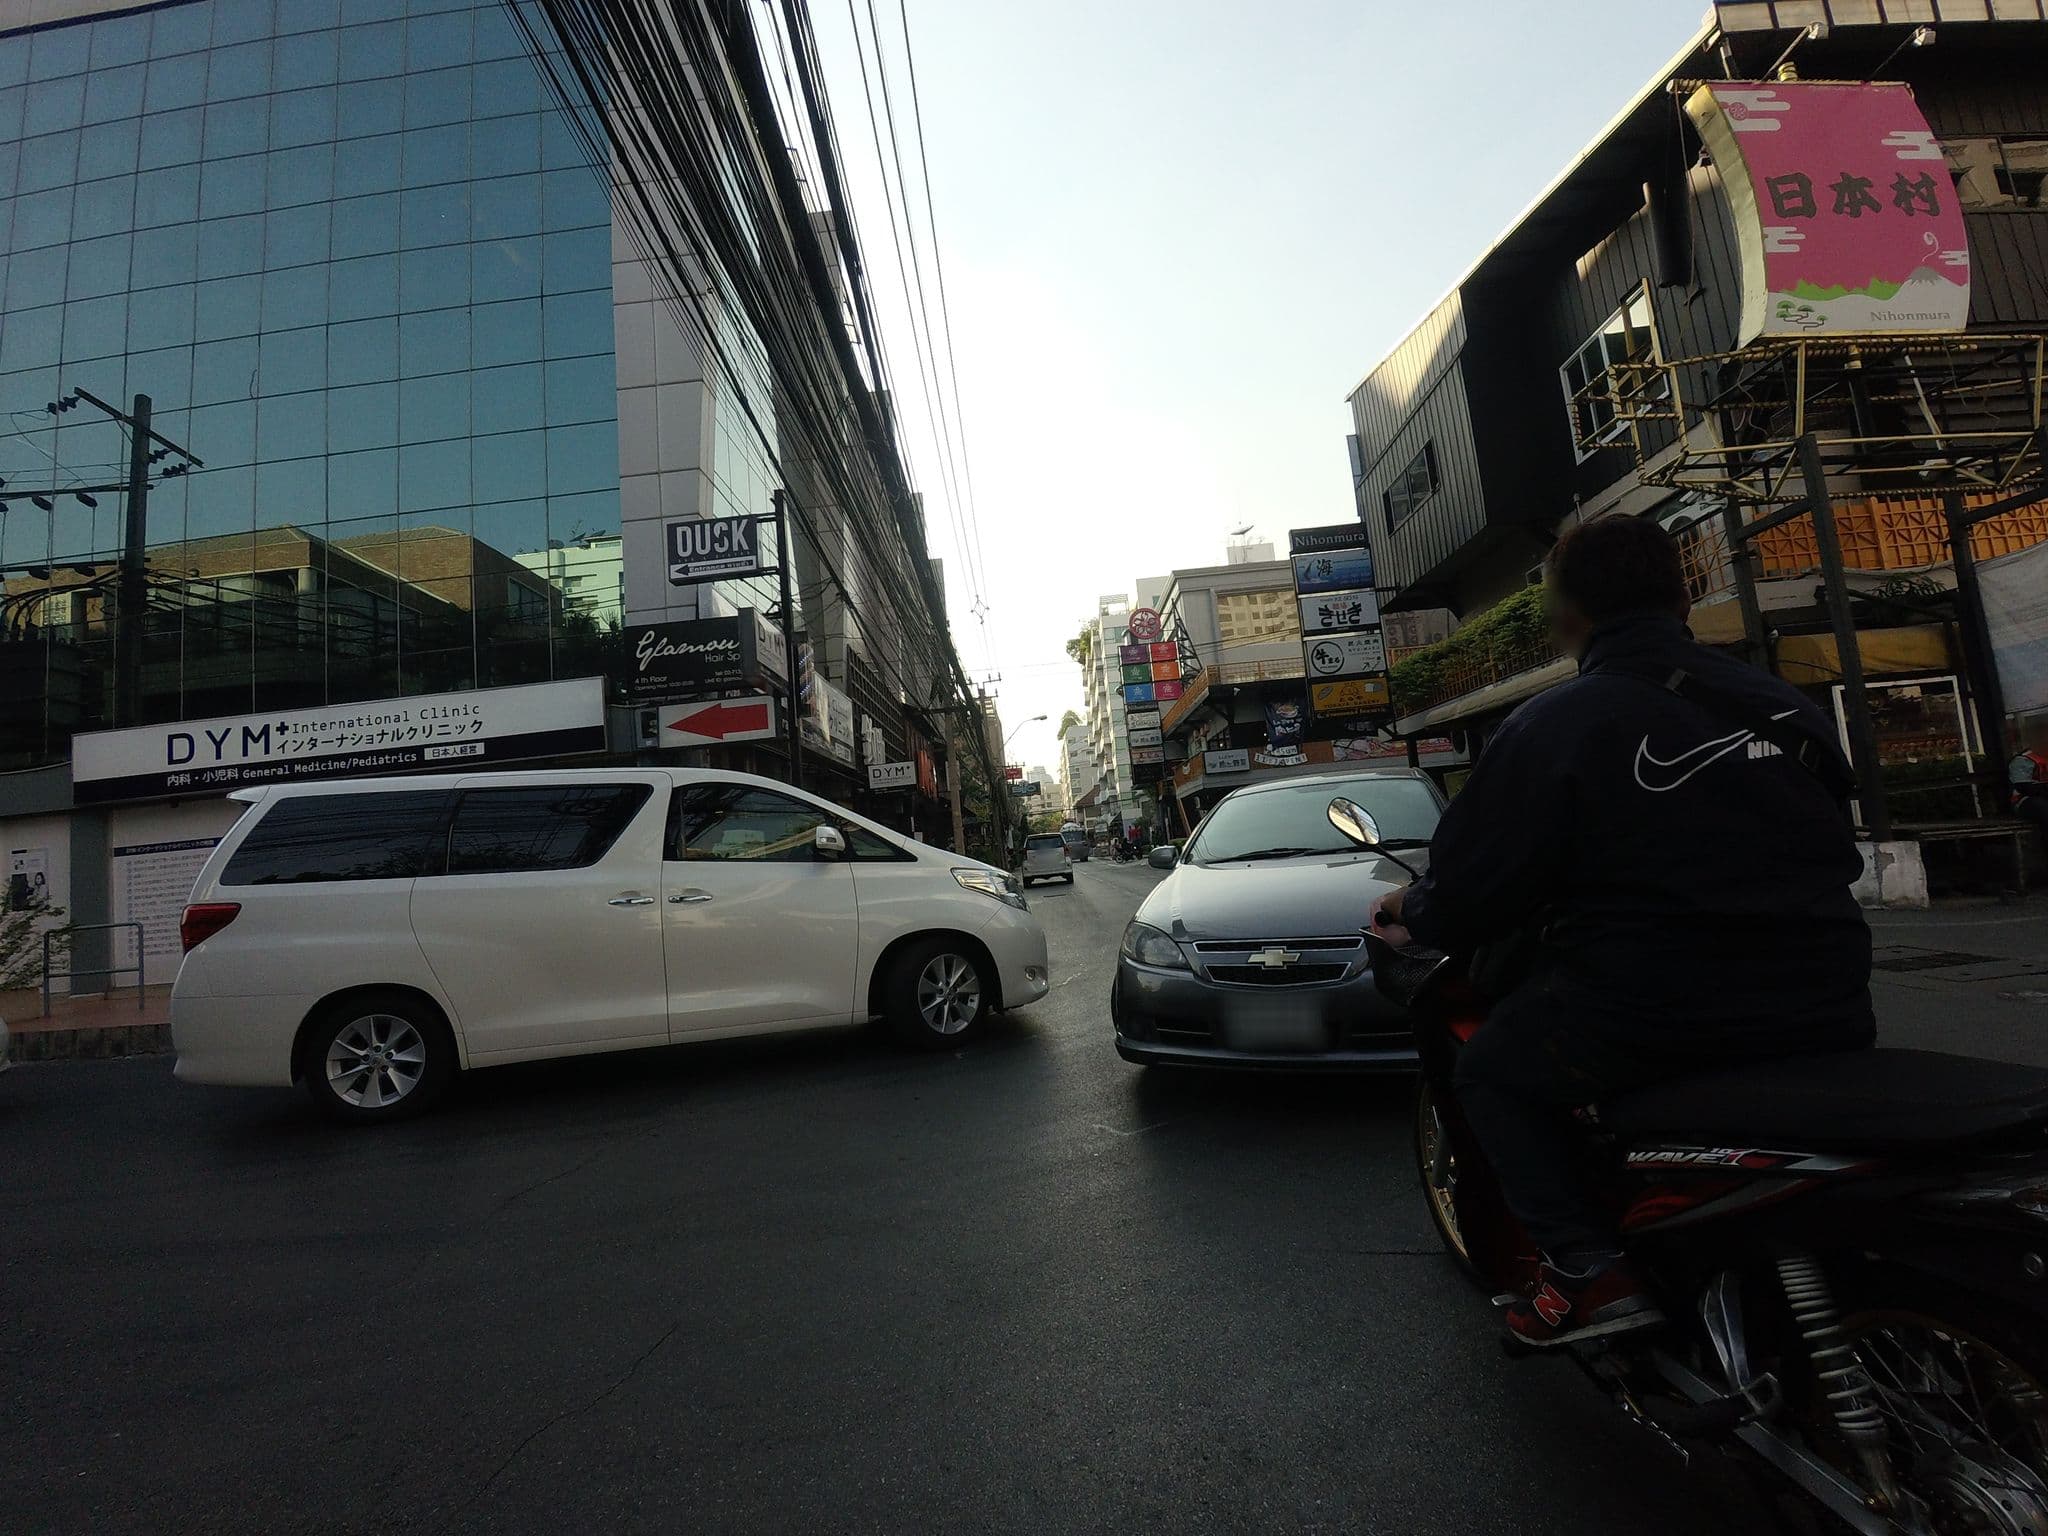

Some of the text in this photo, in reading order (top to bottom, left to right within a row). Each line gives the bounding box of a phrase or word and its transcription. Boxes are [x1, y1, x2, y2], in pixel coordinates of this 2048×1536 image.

[1764, 171, 1941, 219] 日本村
[1869, 310, 1951, 323] Nihonmura
[676, 519, 749, 557] DUSK
[1294, 532, 1365, 547] Nihonmura
[705, 653, 724, 662] Hair
[292, 704, 480, 734] International Clinic
[167, 723, 270, 766] DYM
[276, 719, 484, 755] インターナショナルクリニック
[431, 745, 478, 758] 日本人経営
[242, 752, 417, 779] General Medicine/Pediatrics
[872, 766, 905, 779] DYM
[167, 768, 239, 787] 内科・小児科
[1627, 1151, 1724, 1164] WAVE
